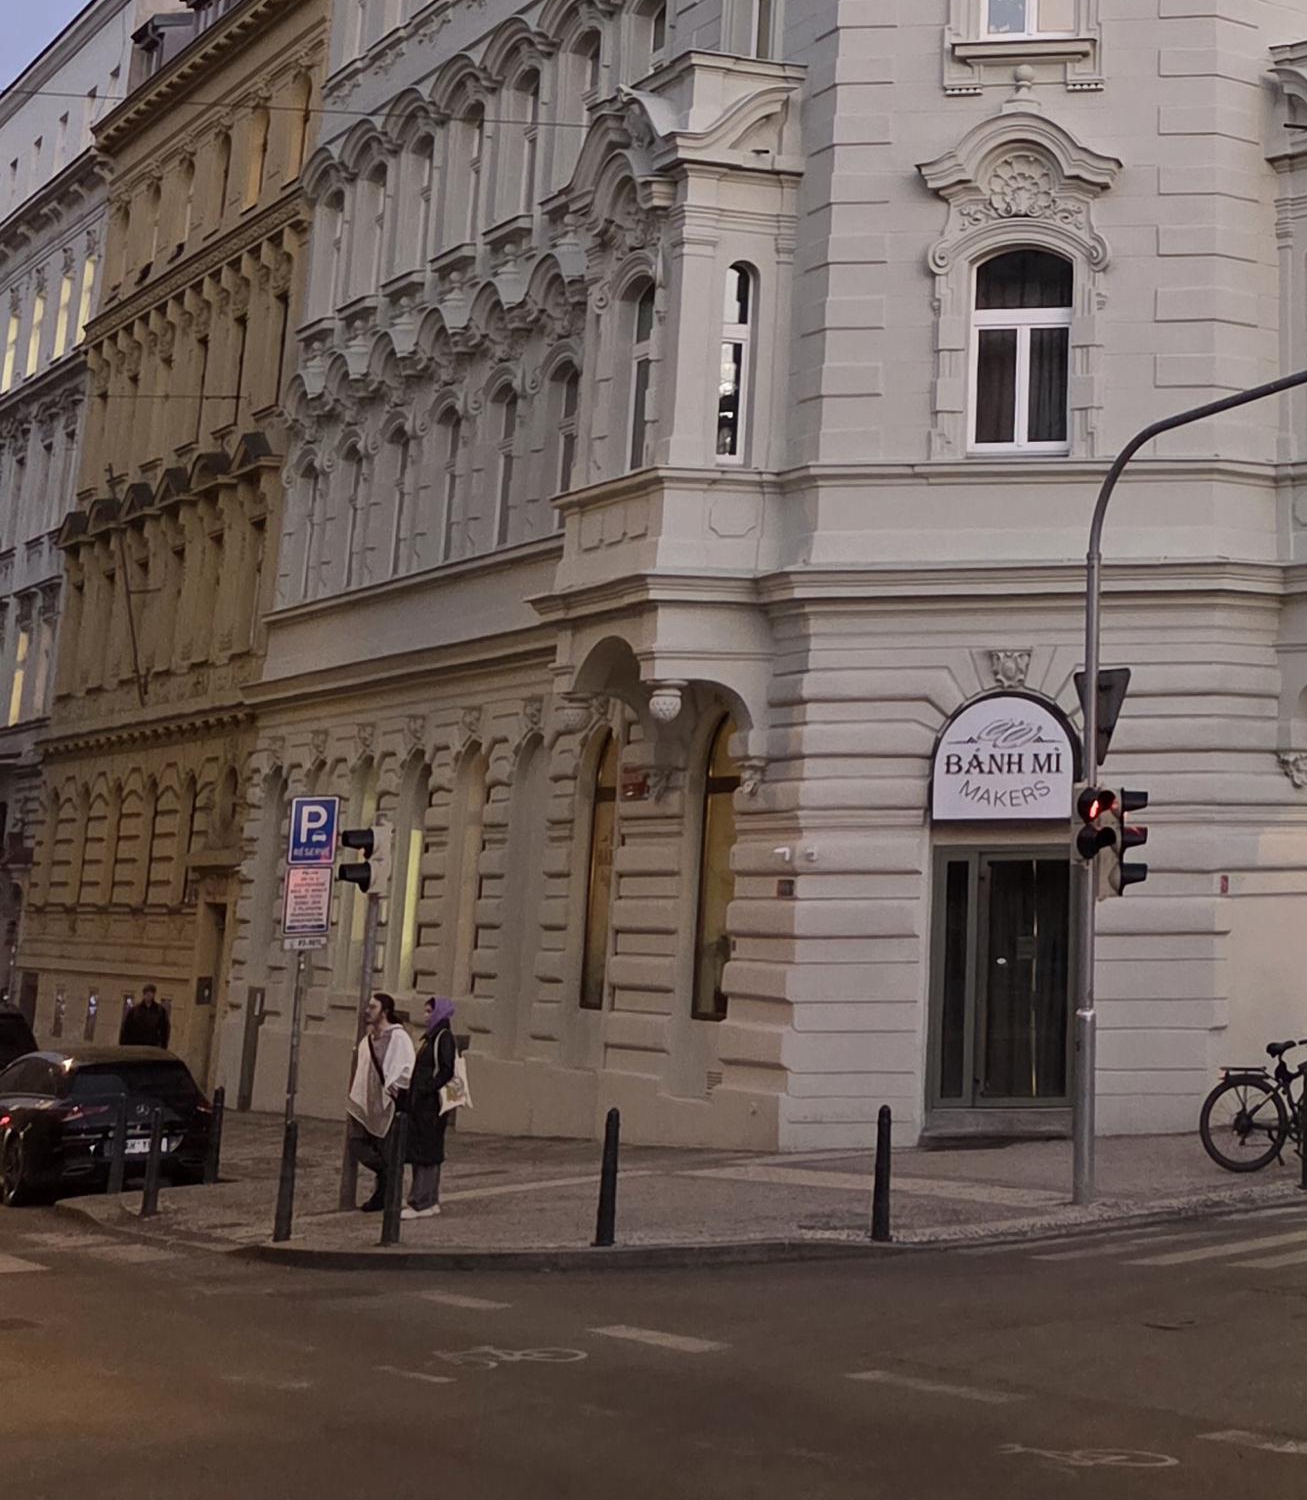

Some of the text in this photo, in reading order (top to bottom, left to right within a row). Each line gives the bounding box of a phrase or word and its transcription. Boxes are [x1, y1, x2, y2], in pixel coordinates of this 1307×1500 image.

[945, 747, 1063, 775] BÁNH MÌ
[959, 779, 1051, 808] MAKERS
[300, 805, 328, 843] P
